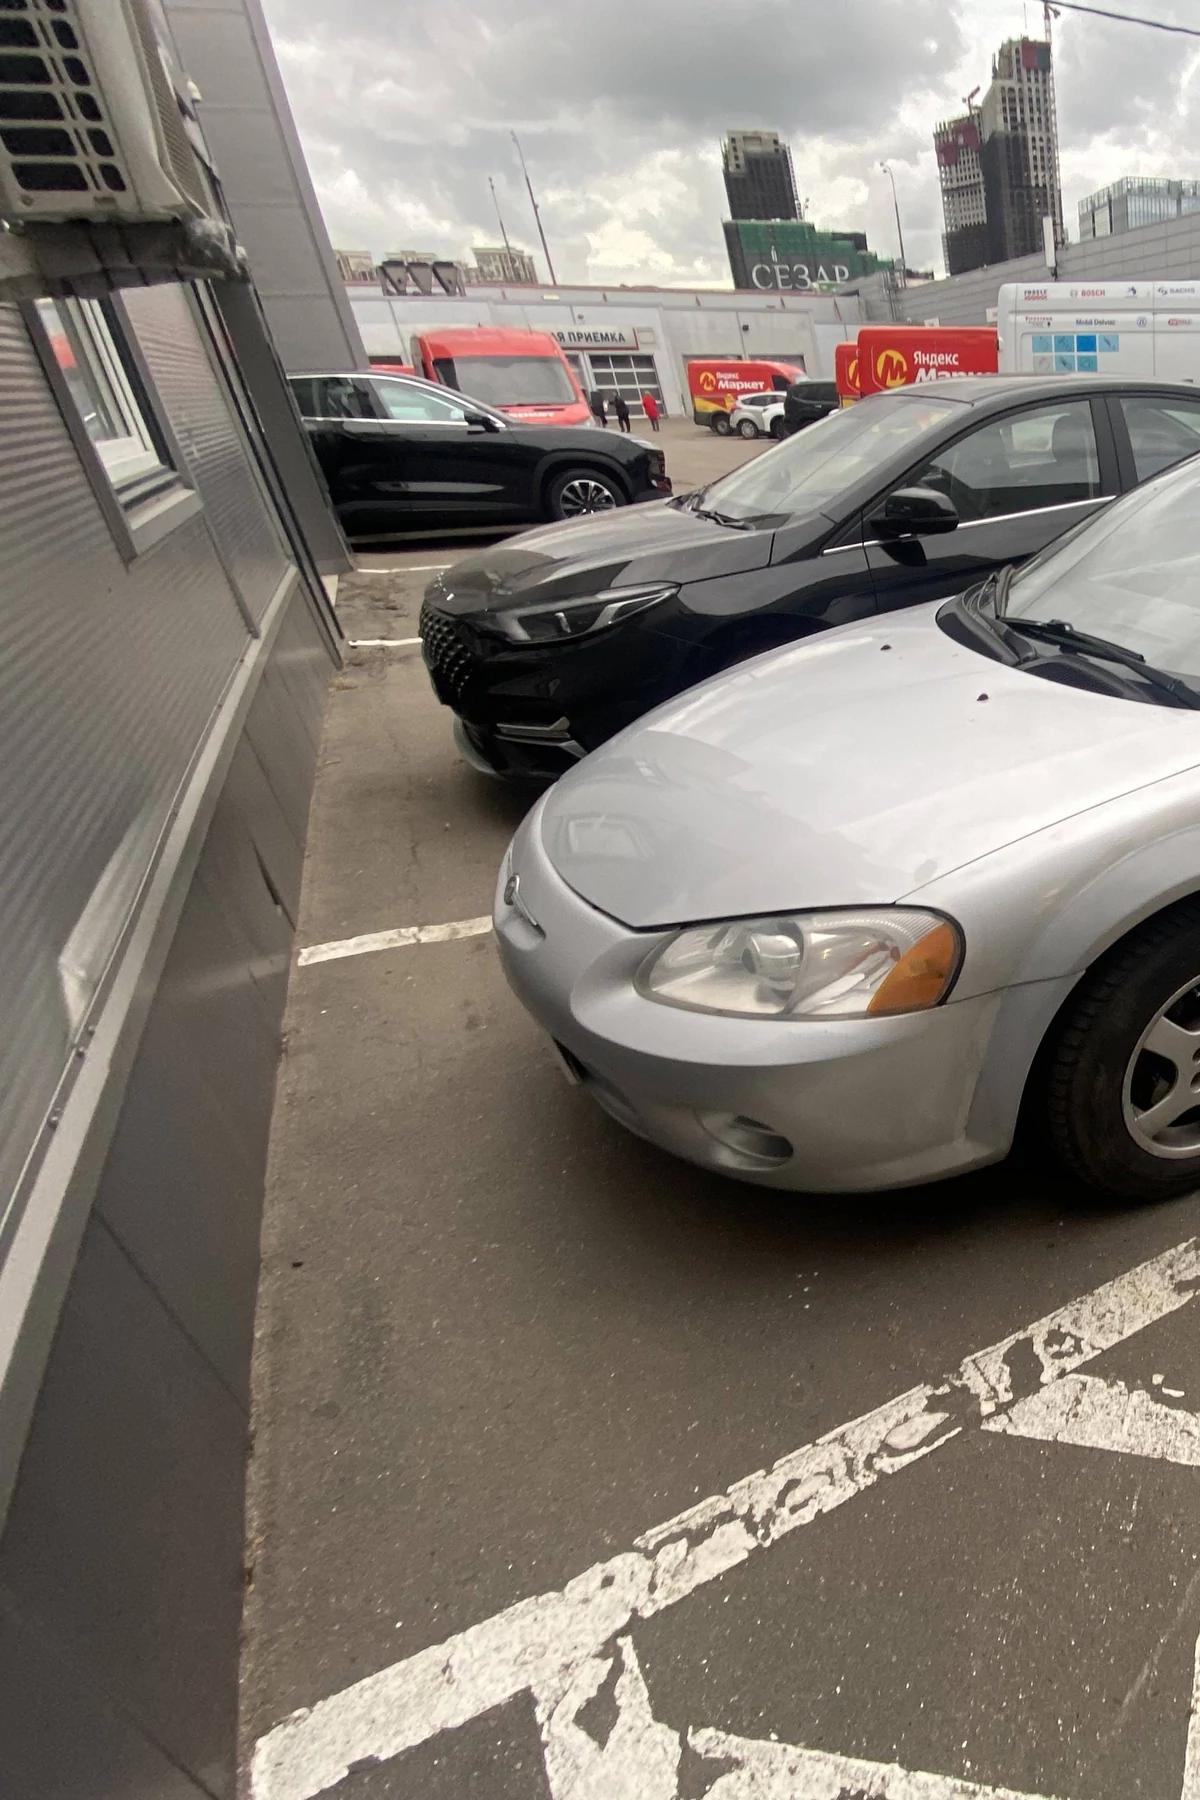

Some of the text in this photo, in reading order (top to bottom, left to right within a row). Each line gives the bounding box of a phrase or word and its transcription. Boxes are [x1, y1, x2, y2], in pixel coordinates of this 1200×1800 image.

[752, 264, 849, 290] СЕЗАР
[1081, 289, 1106, 297] BOSCH
[568, 332, 626, 342] ПРИЕМКА
[913, 350, 959, 367] Яндекс
[718, 380, 765, 391] Маркет
